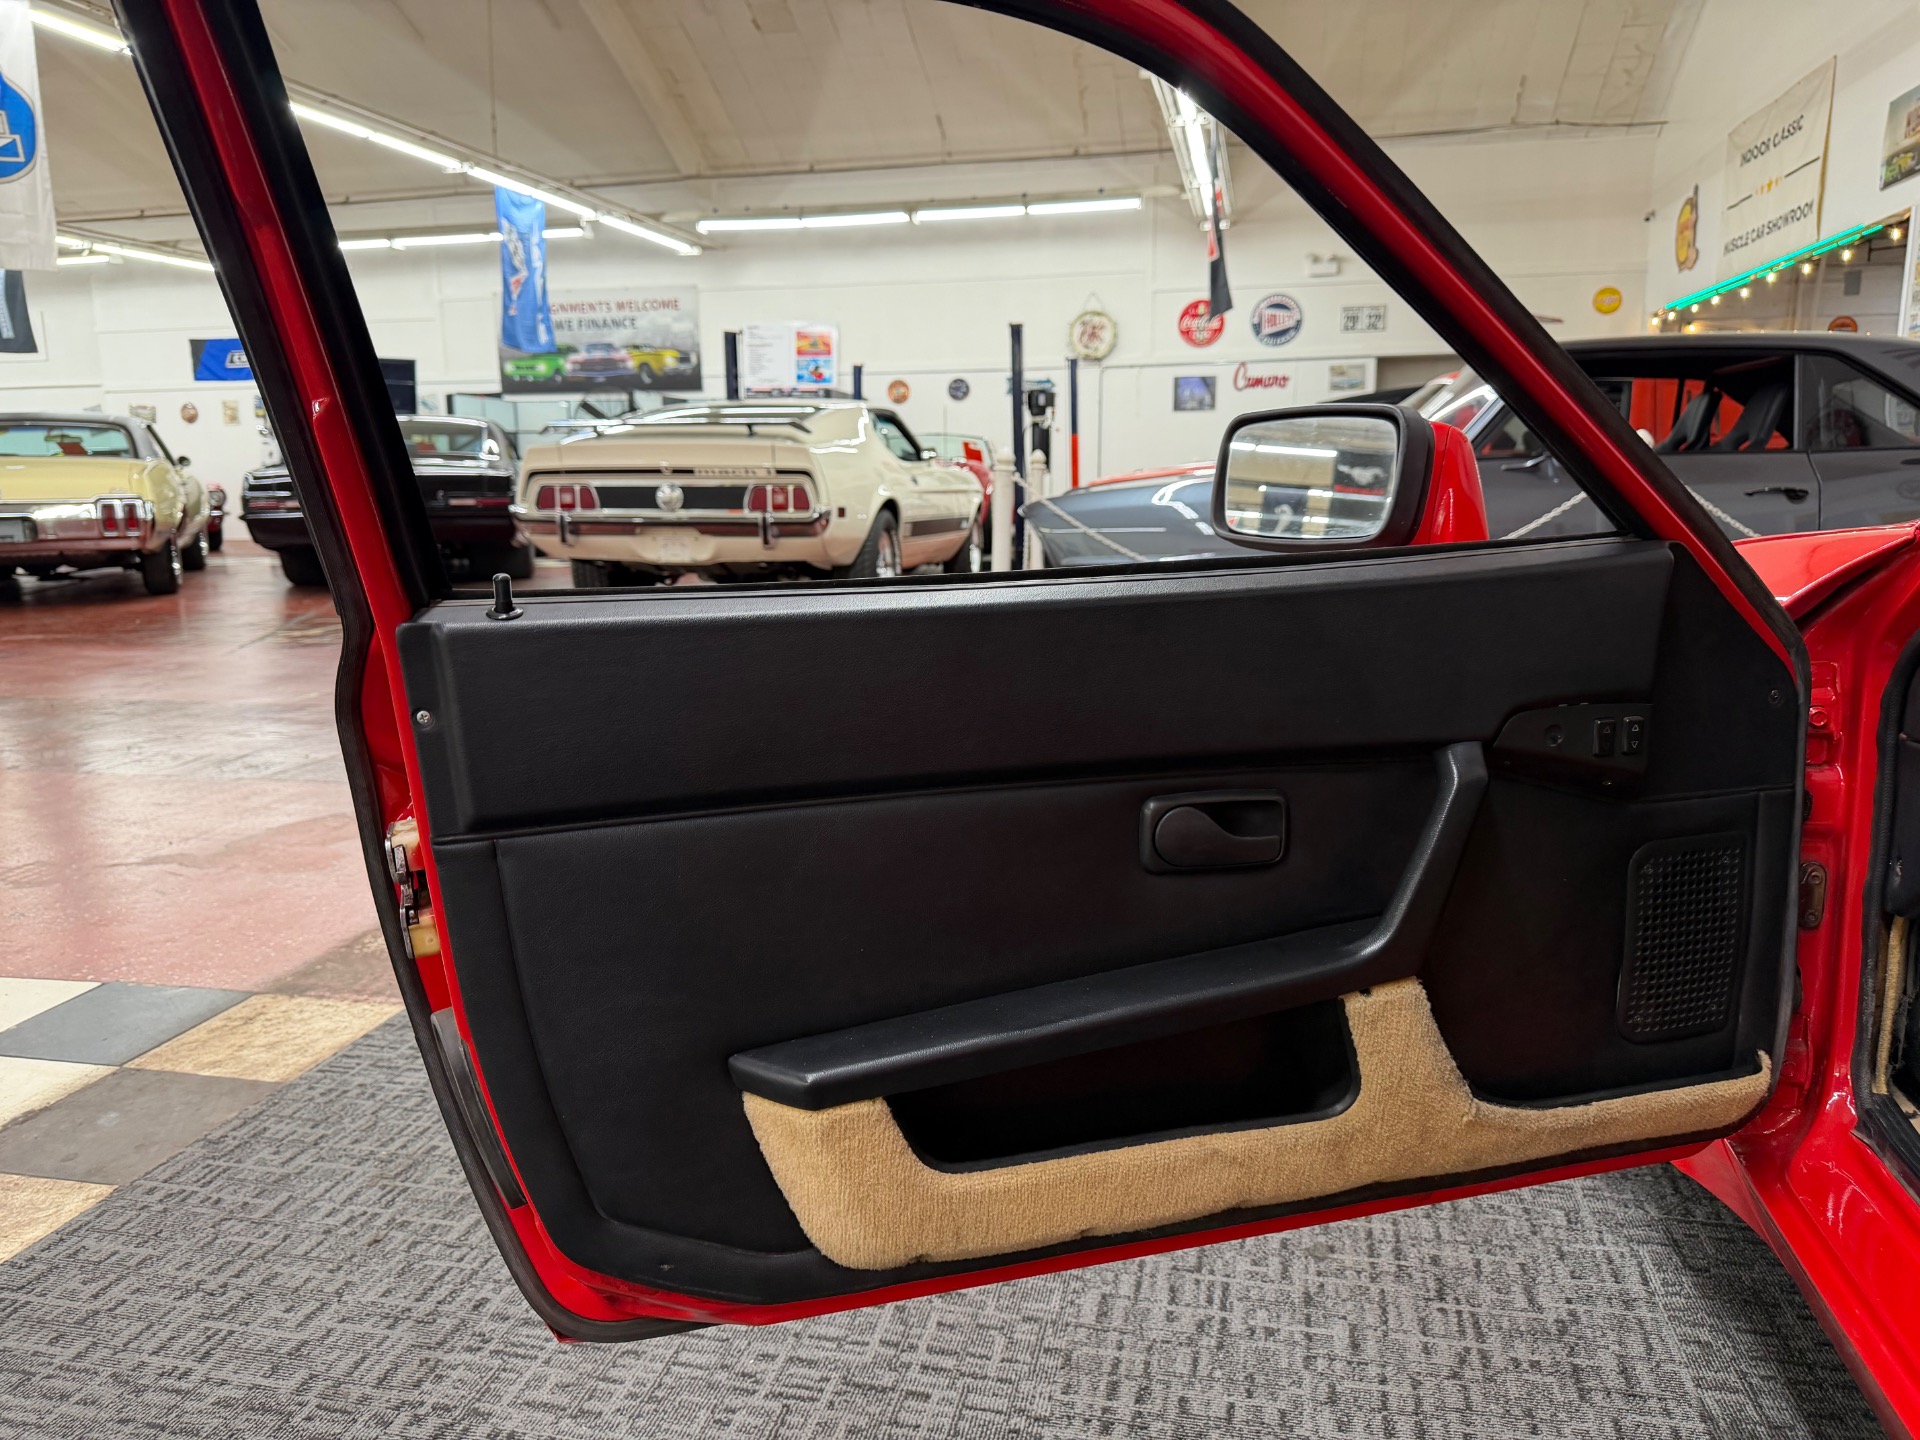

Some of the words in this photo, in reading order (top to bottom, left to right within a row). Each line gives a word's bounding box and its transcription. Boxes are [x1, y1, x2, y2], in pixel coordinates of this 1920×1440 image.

[1773, 114, 1804, 148] CLASSIC
[1751, 223, 1765, 243] CAR
[550, 301, 611, 315] GNMENTS
[616, 298, 680, 313] WELCOME
[577, 315, 639, 331] FINANCE
[1233, 361, 1290, 391] Camaro
